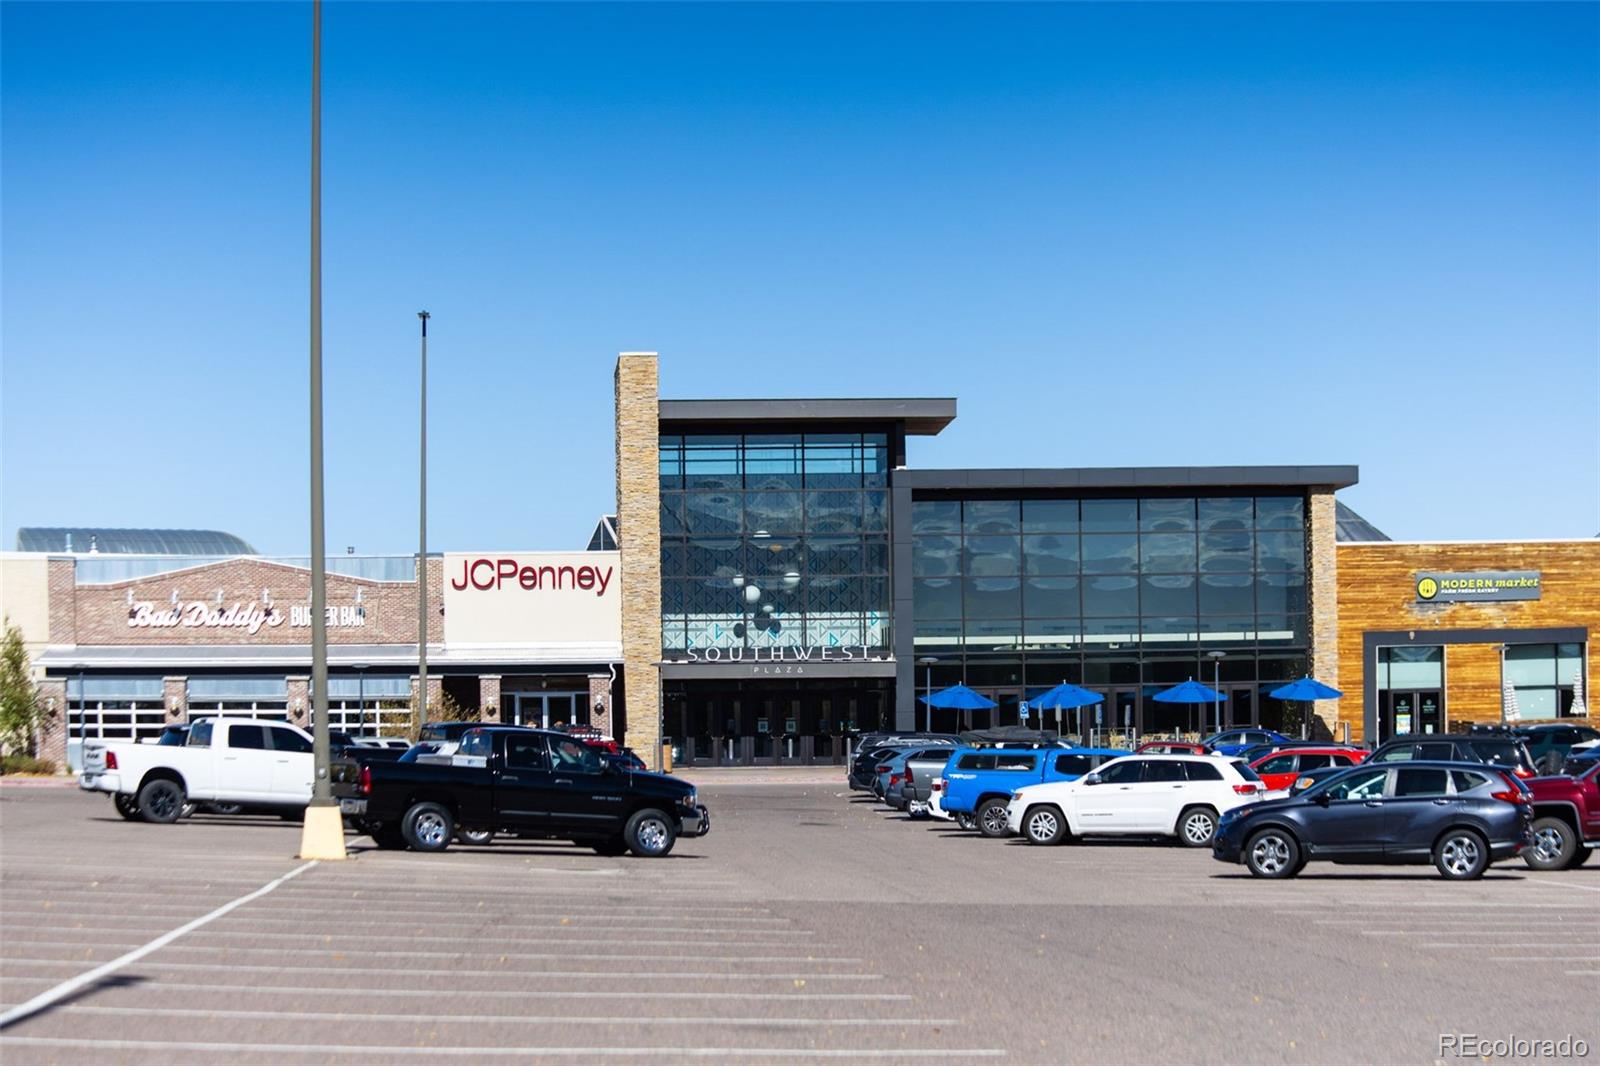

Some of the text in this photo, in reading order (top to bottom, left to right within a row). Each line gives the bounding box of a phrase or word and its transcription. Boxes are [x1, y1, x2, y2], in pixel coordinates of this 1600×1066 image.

[451, 559, 613, 597] JCPenney
[1441, 577, 1539, 589] MODERN market
[128, 602, 183, 628] Bad
[183, 601, 285, 635] Daddy's
[290, 606, 338, 628] BUER
[687, 646, 871, 661] SOUTHWEST
[753, 666, 803, 674] PLAZA
